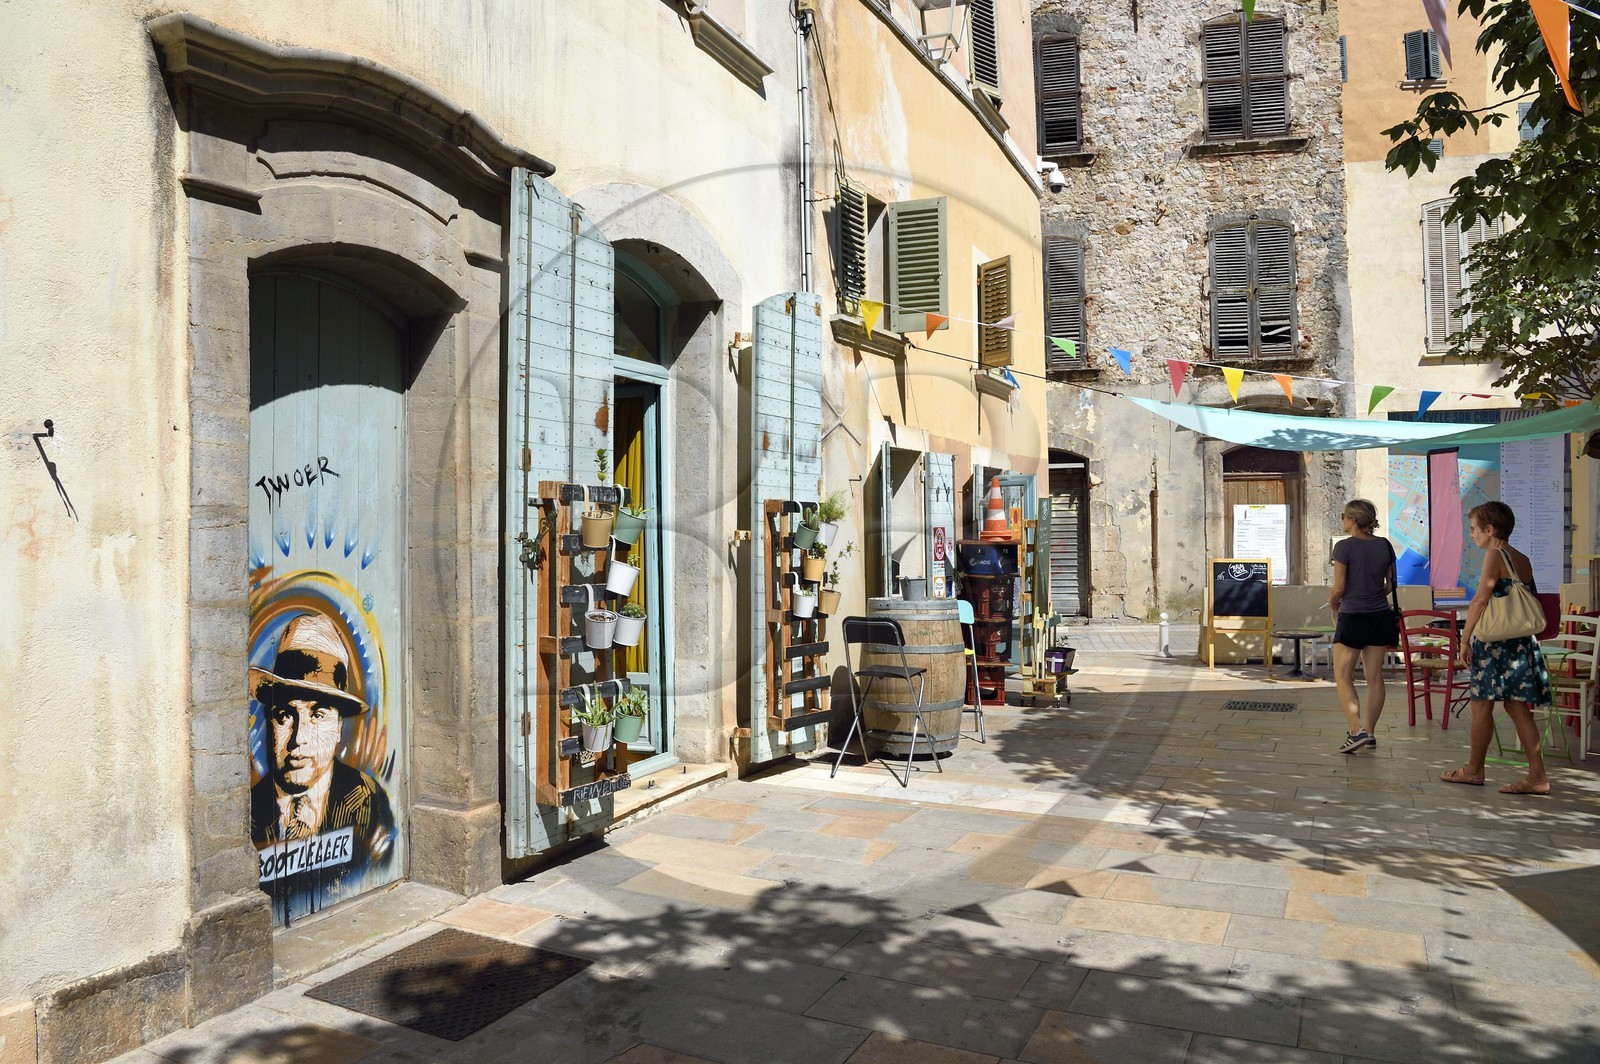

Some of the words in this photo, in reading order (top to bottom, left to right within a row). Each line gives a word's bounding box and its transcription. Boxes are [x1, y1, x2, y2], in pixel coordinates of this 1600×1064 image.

[1454, 411, 1470, 422] SON
[1474, 410, 1501, 423] CŒUR
[255, 456, 341, 512] TWOER
